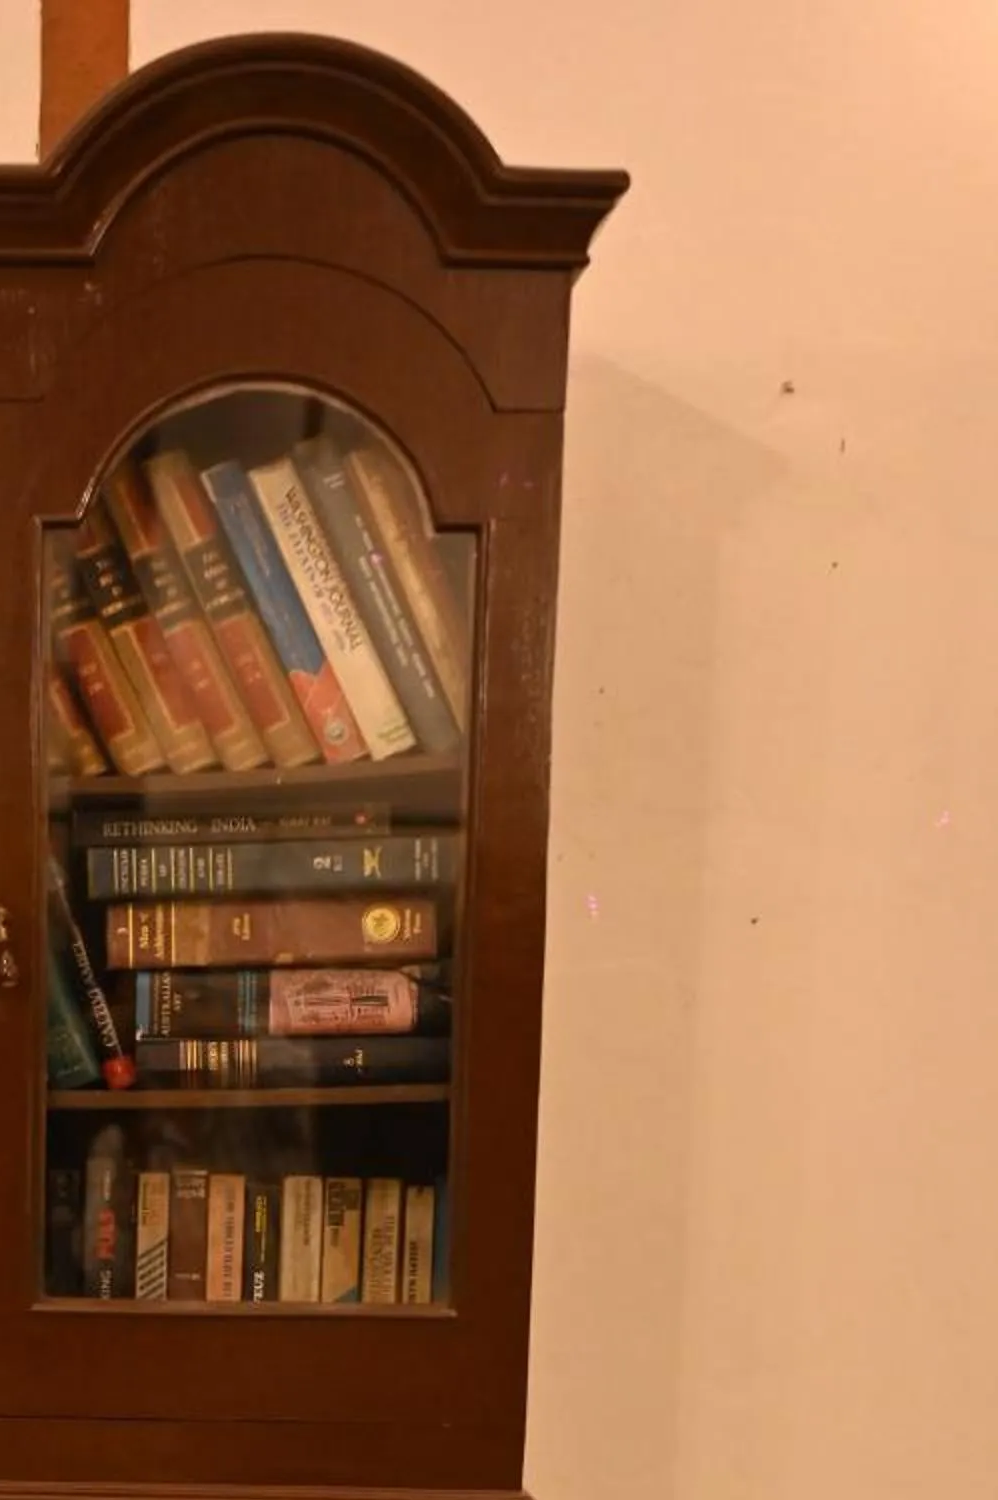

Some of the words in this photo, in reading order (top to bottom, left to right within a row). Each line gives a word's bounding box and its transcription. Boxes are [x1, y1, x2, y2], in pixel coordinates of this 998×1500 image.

[282, 484, 331, 579] WASHINGTON
[326, 585, 364, 650] JOURNAL
[103, 818, 199, 838] RETHINKING
[210, 815, 257, 833] INDIA
